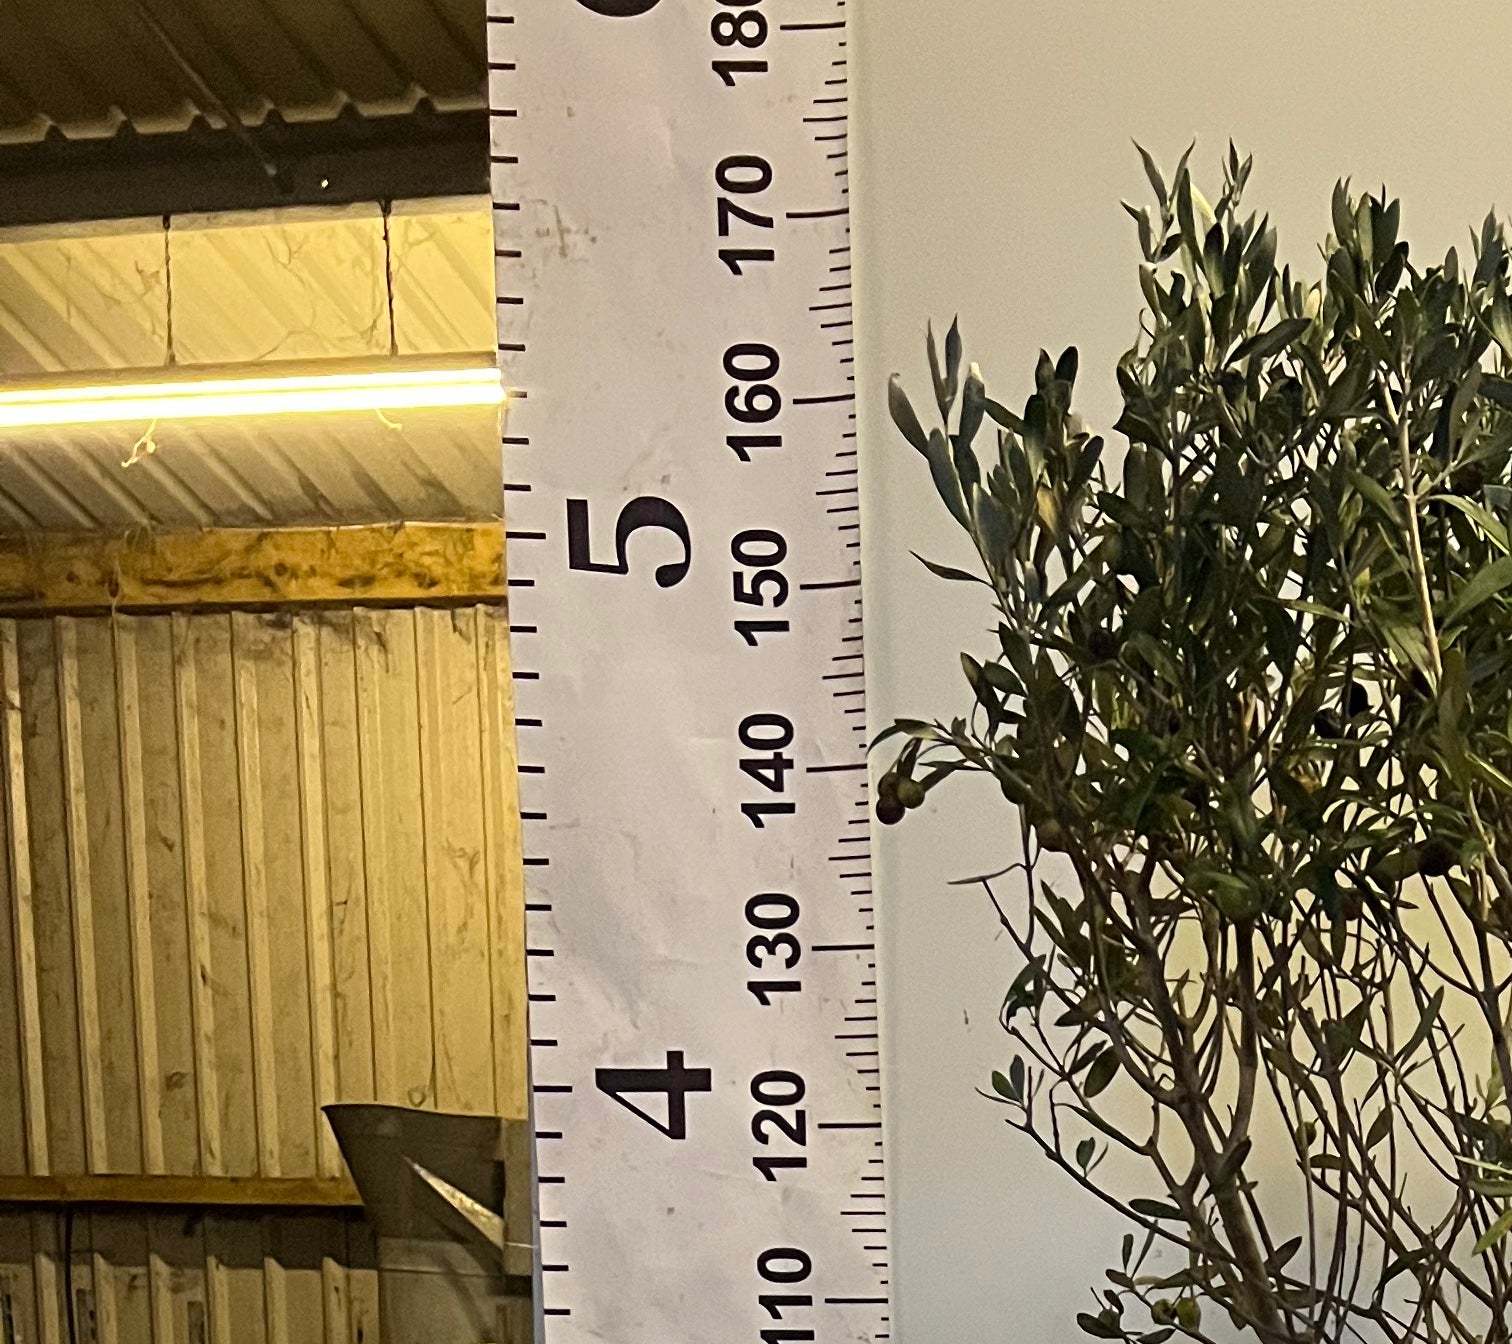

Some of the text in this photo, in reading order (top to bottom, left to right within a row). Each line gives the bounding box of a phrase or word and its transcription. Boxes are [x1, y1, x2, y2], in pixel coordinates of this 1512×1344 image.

[710, 0, 769, 87] 18
[715, 155, 775, 276] 170
[722, 343, 783, 462] 160
[566, 496, 692, 588] 5
[730, 529, 790, 647] 150
[738, 713, 796, 829] 140
[744, 893, 802, 1006] 130
[594, 1050, 712, 1140] 4
[750, 1070, 808, 1182] 120
